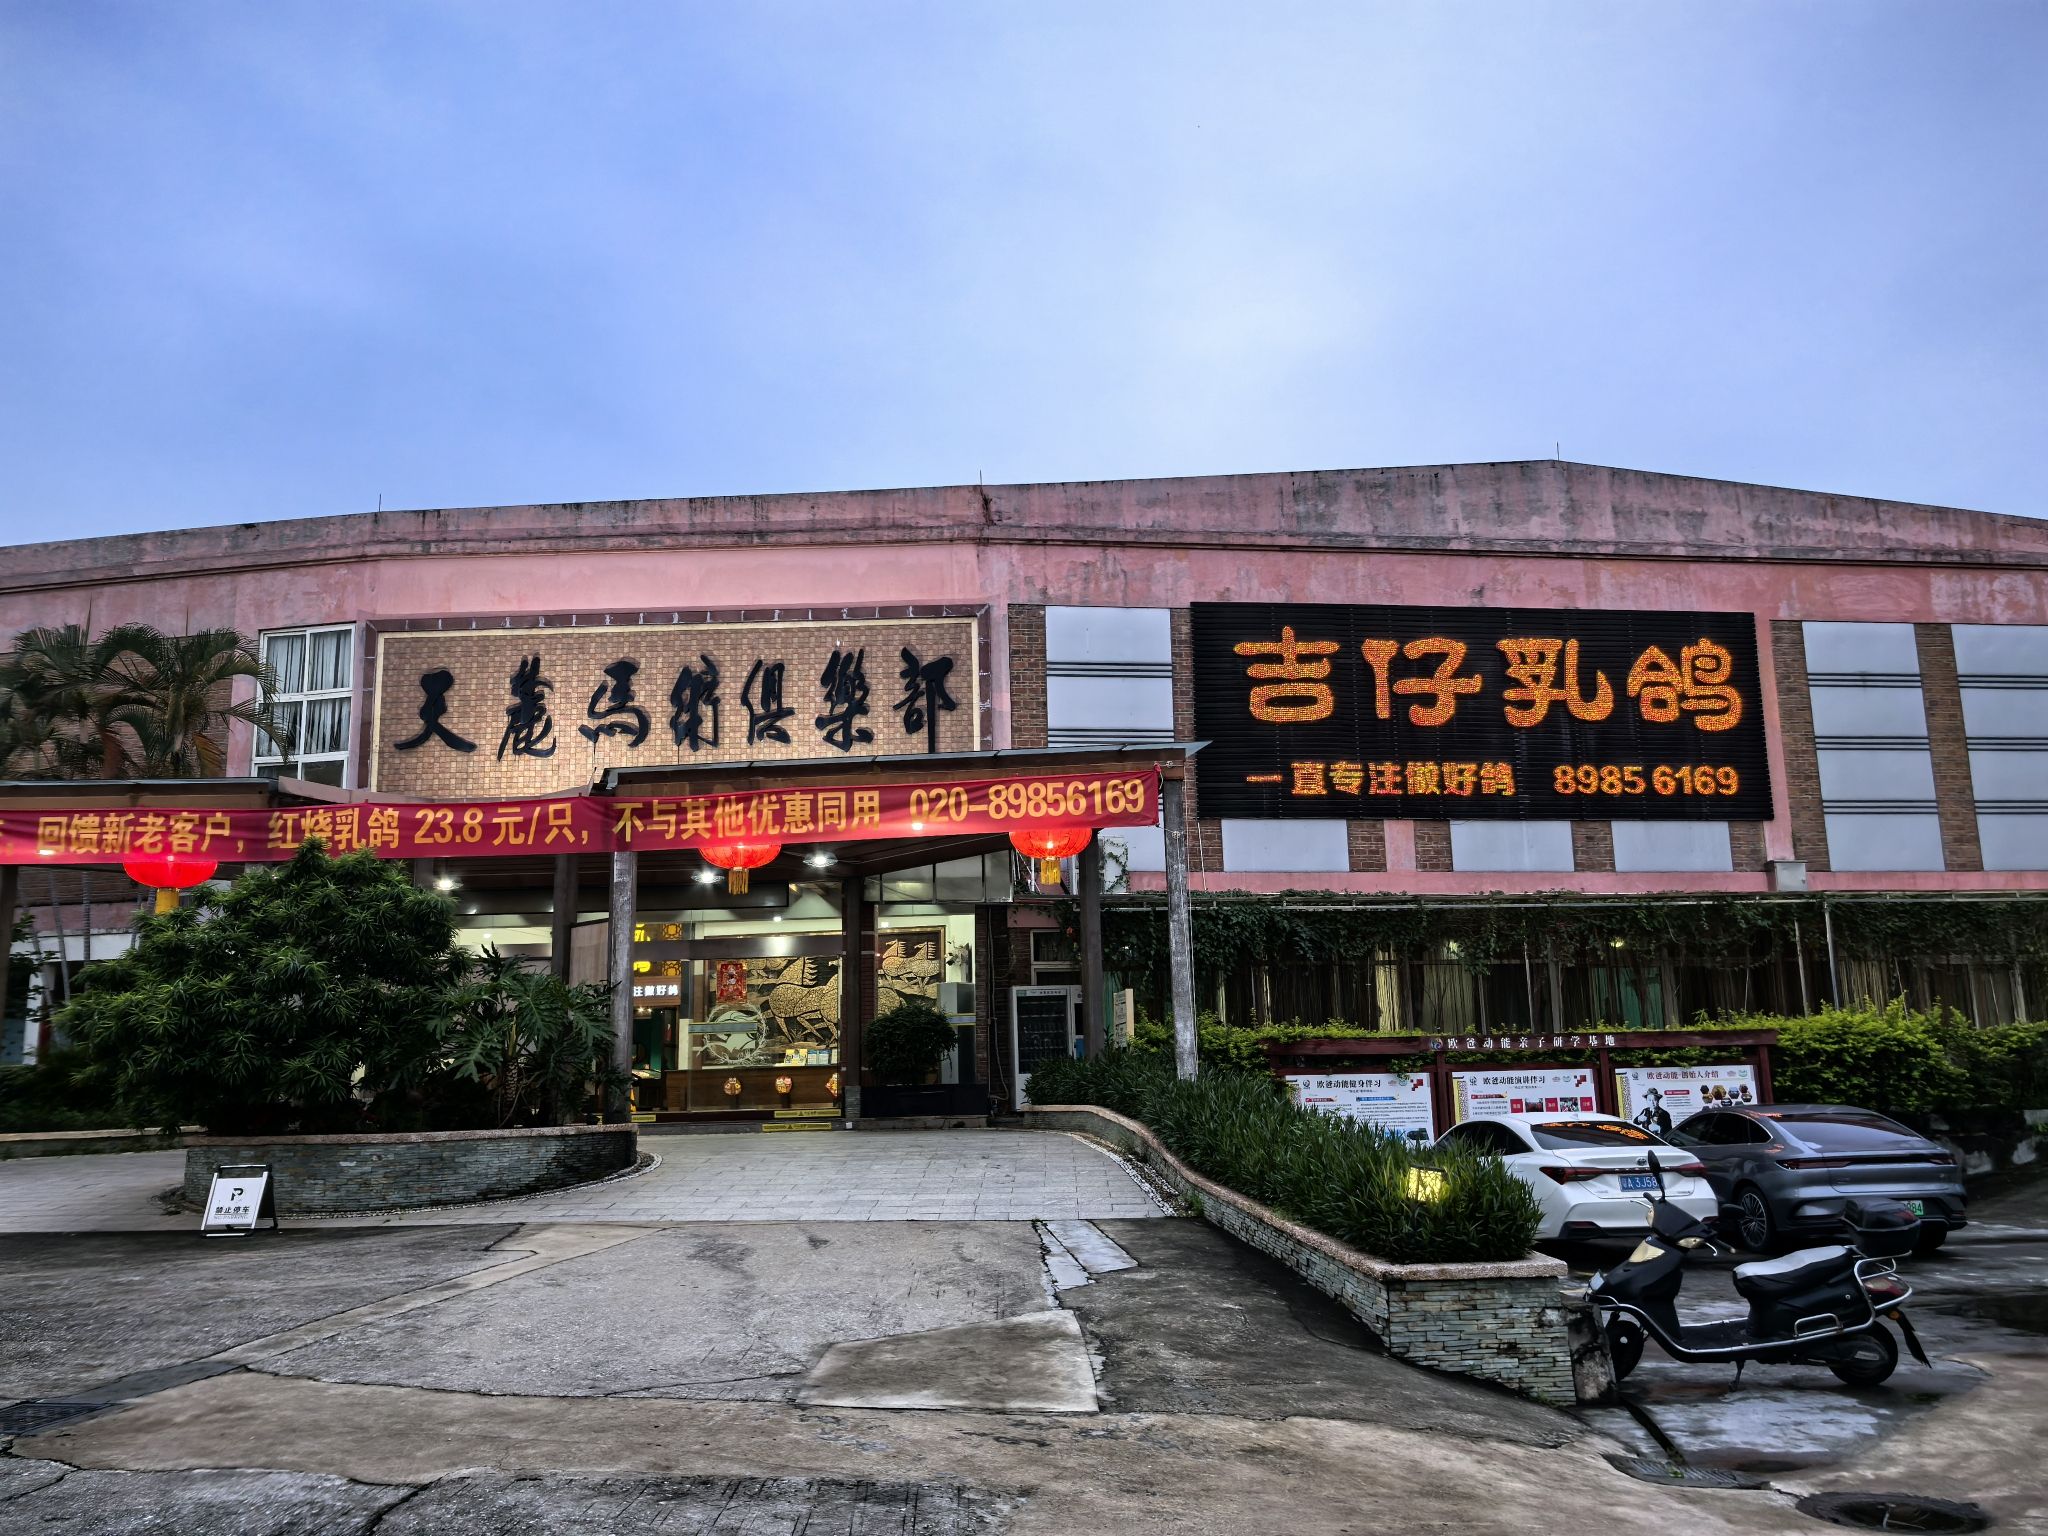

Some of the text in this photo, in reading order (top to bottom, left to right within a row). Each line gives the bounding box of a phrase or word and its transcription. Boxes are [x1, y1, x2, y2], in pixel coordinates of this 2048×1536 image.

[1233, 625, 1743, 732] 吉仔乳鸽
[612, 790, 880, 843] 不与其他优惠同用
[909, 778, 1145, 823] 020-89856169
[1246, 761, 1515, 797] 一直专注做好鸽
